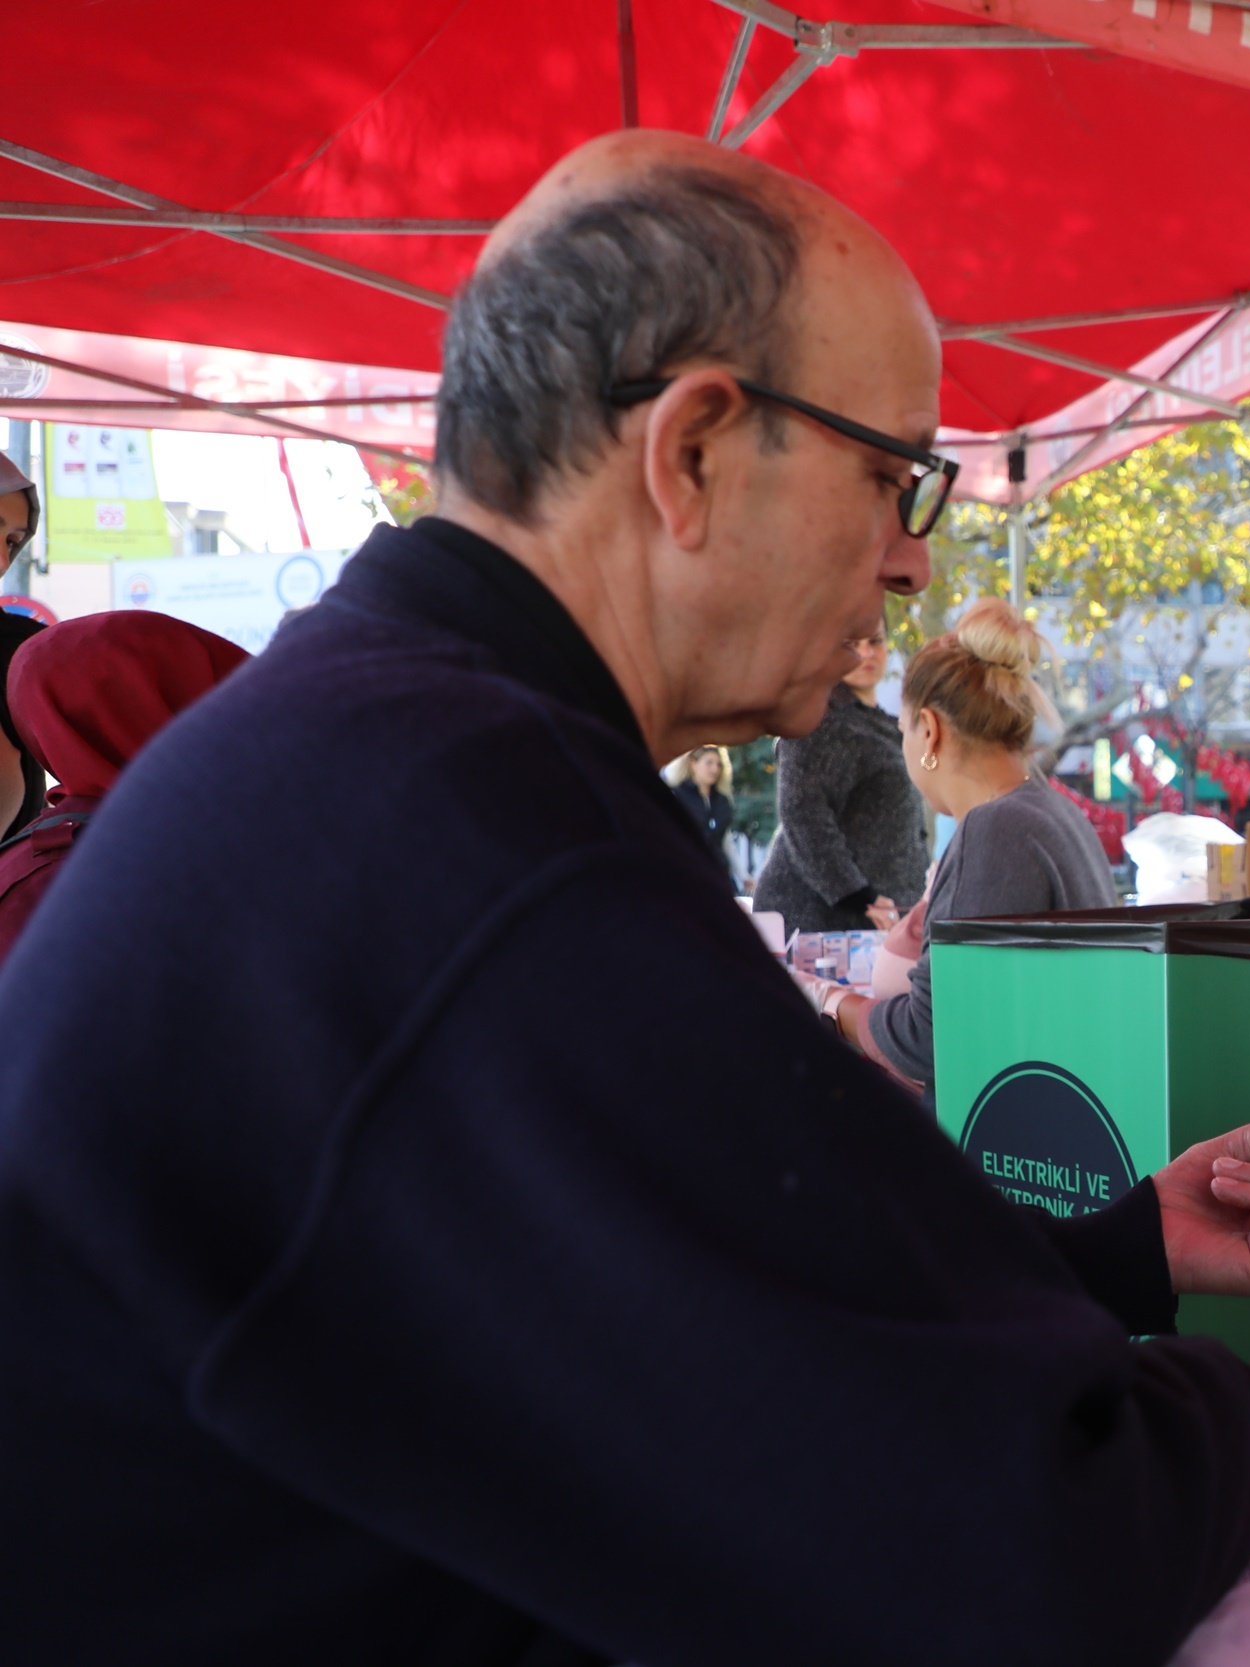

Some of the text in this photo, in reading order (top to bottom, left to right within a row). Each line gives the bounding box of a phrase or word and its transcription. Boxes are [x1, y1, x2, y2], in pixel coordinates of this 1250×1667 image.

[983, 1150, 1111, 1200] ELEKTRİKLİ VE
[992, 1184, 1075, 1218] KTRONİK
